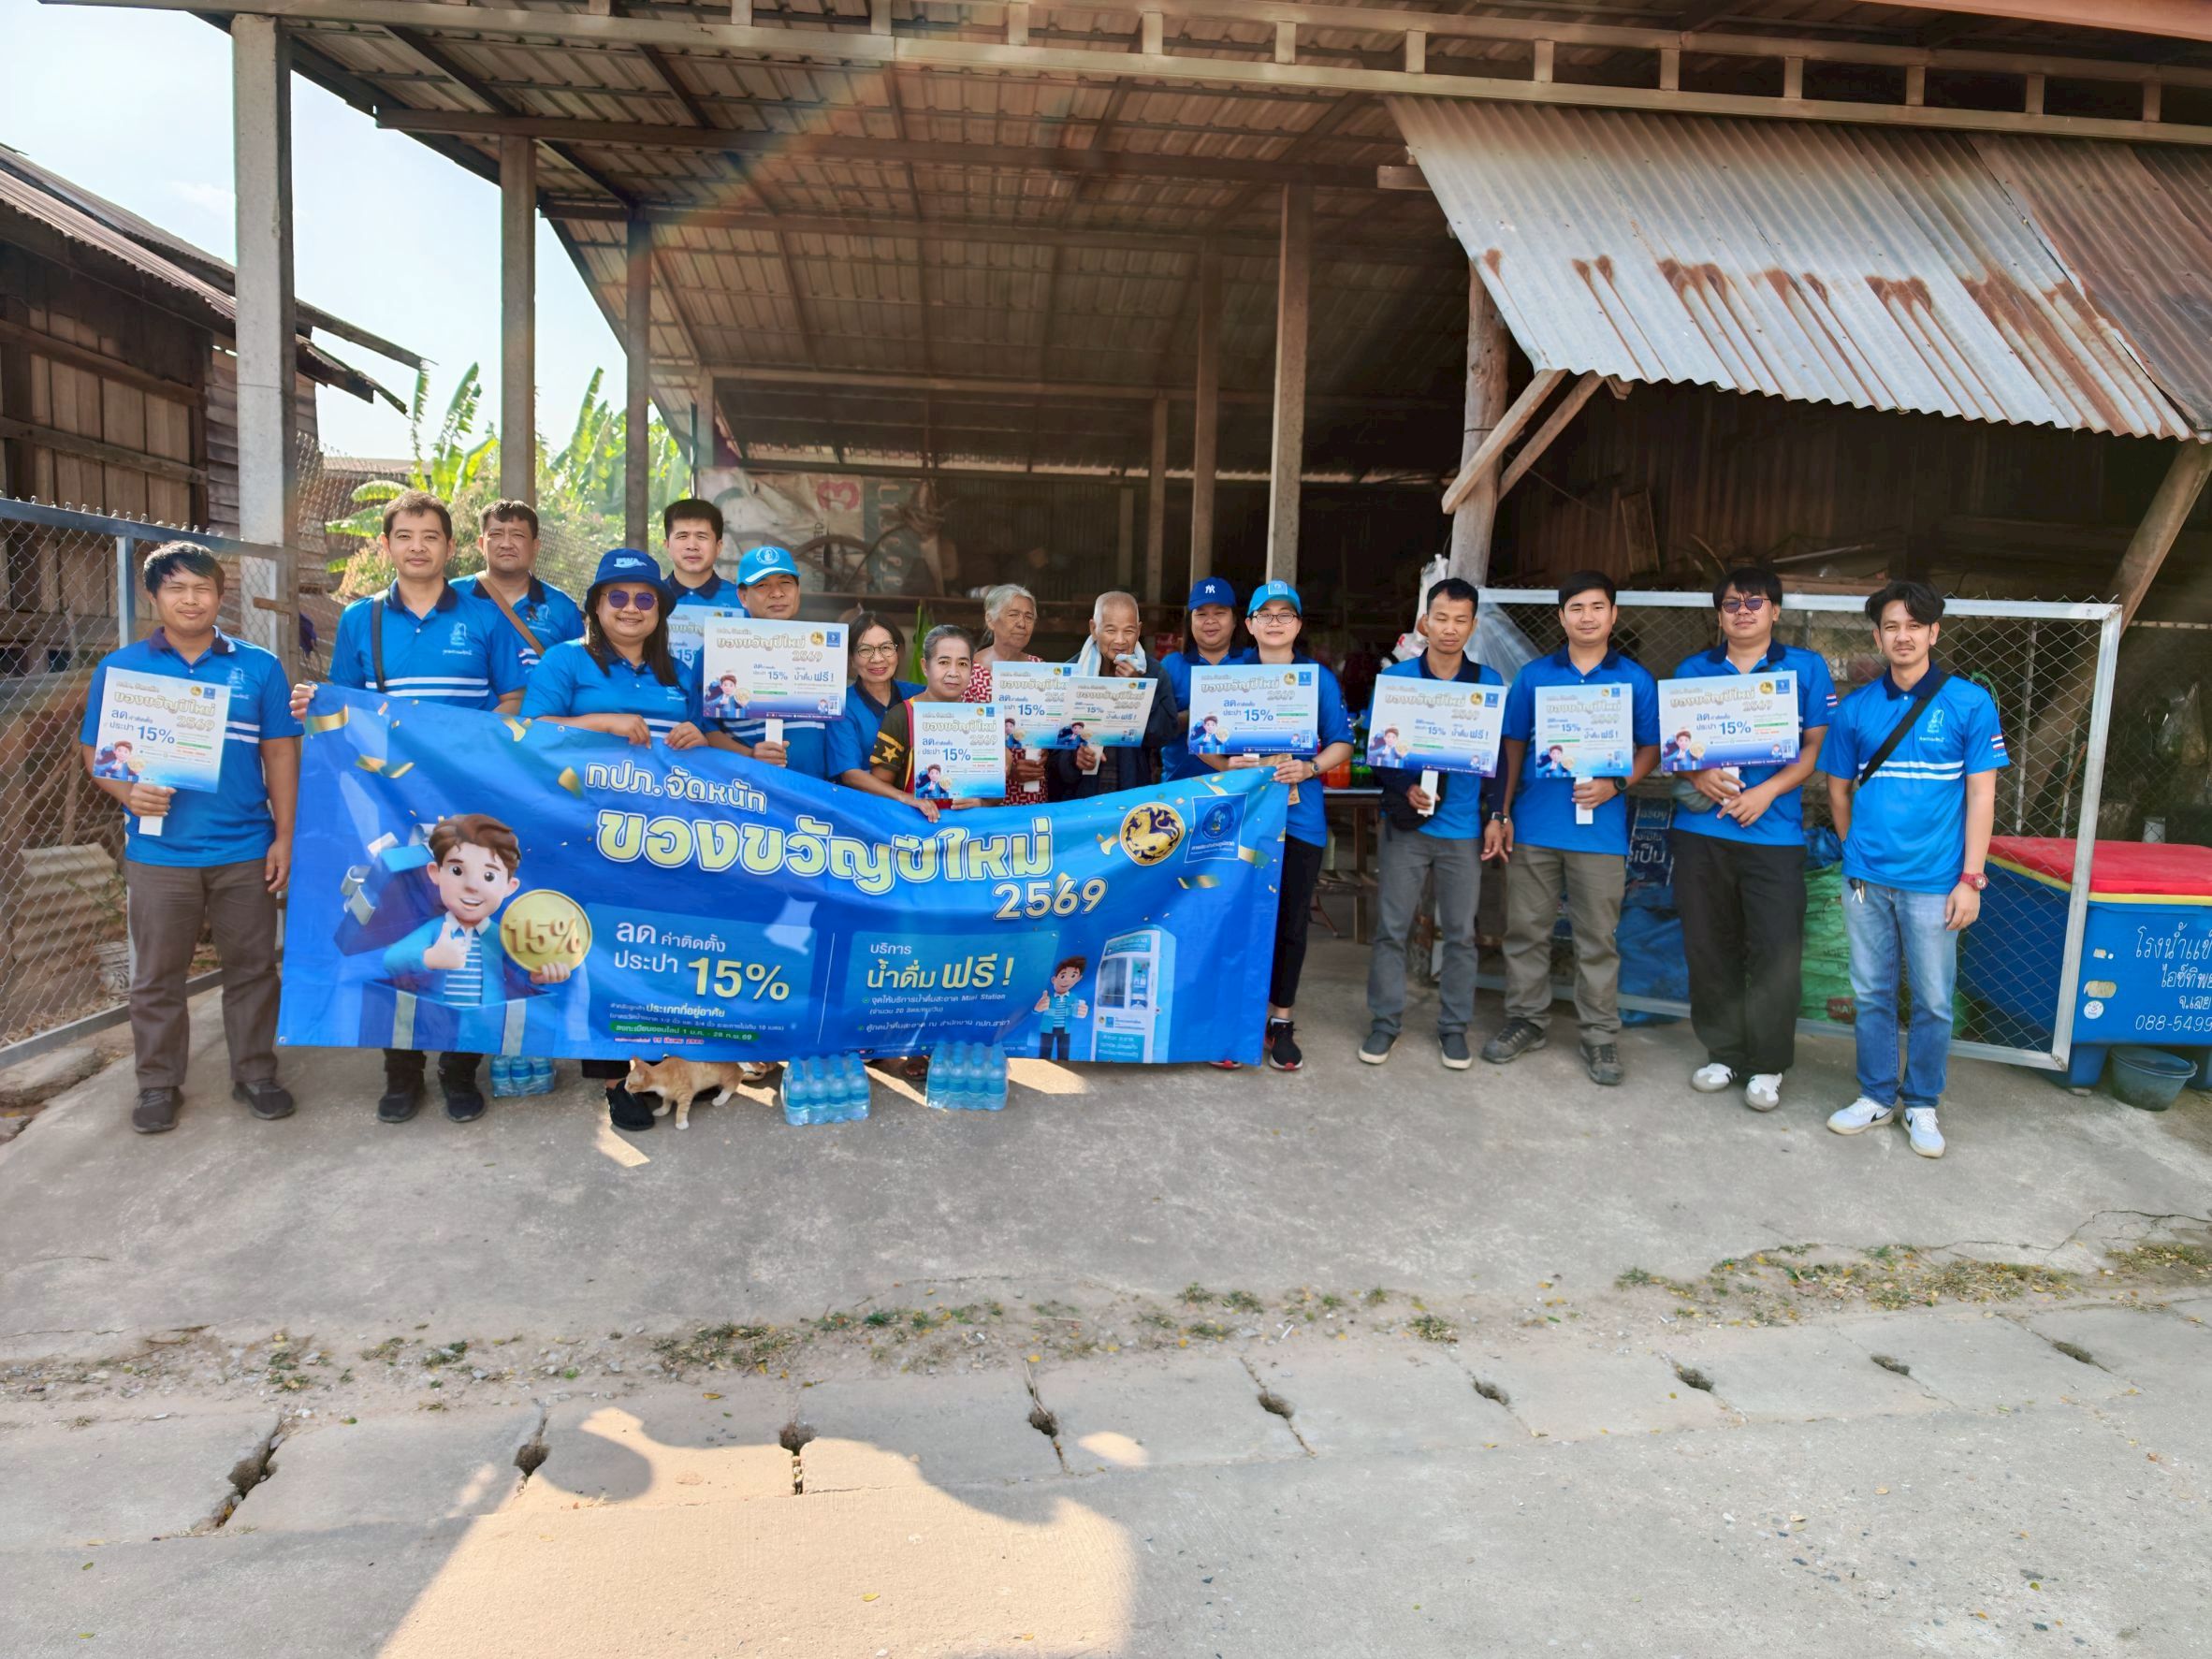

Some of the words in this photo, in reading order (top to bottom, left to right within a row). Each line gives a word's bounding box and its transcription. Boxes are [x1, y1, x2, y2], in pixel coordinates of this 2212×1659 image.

[717, 633, 806, 651] ของขวัญปีใหม่
[767, 671, 788, 681] 15%
[114, 691, 216, 717] ของขวัญปีใหม่
[1018, 704, 1045, 716] 15%
[1223, 699, 1236, 707] ลด
[110, 708, 128, 720] ลด
[1244, 708, 1273, 721] 15%
[1696, 712, 1710, 721] ลด
[138, 725, 175, 744] 15%
[1428, 726, 1447, 735] 15%
[1720, 721, 1751, 735] 15%
[923, 737, 934, 746] ลด
[943, 749, 970, 761] 15%
[596, 808, 1054, 895] ของขวัญปีใหม่
[994, 877, 1108, 921] 2569
[503, 918, 582, 954] 15%
[616, 922, 656, 944] ลด
[661, 932, 726, 953] ค่าติดตั้ง
[870, 941, 912, 955] บริการ
[614, 950, 678, 974] ประปา
[689, 957, 790, 1001] 15%
[866, 958, 937, 989] น้ำดื่ม
[941, 953, 998, 990] ฟรี
[1001, 956, 1015, 986] !
[980, 992, 1006, 1001] Station
